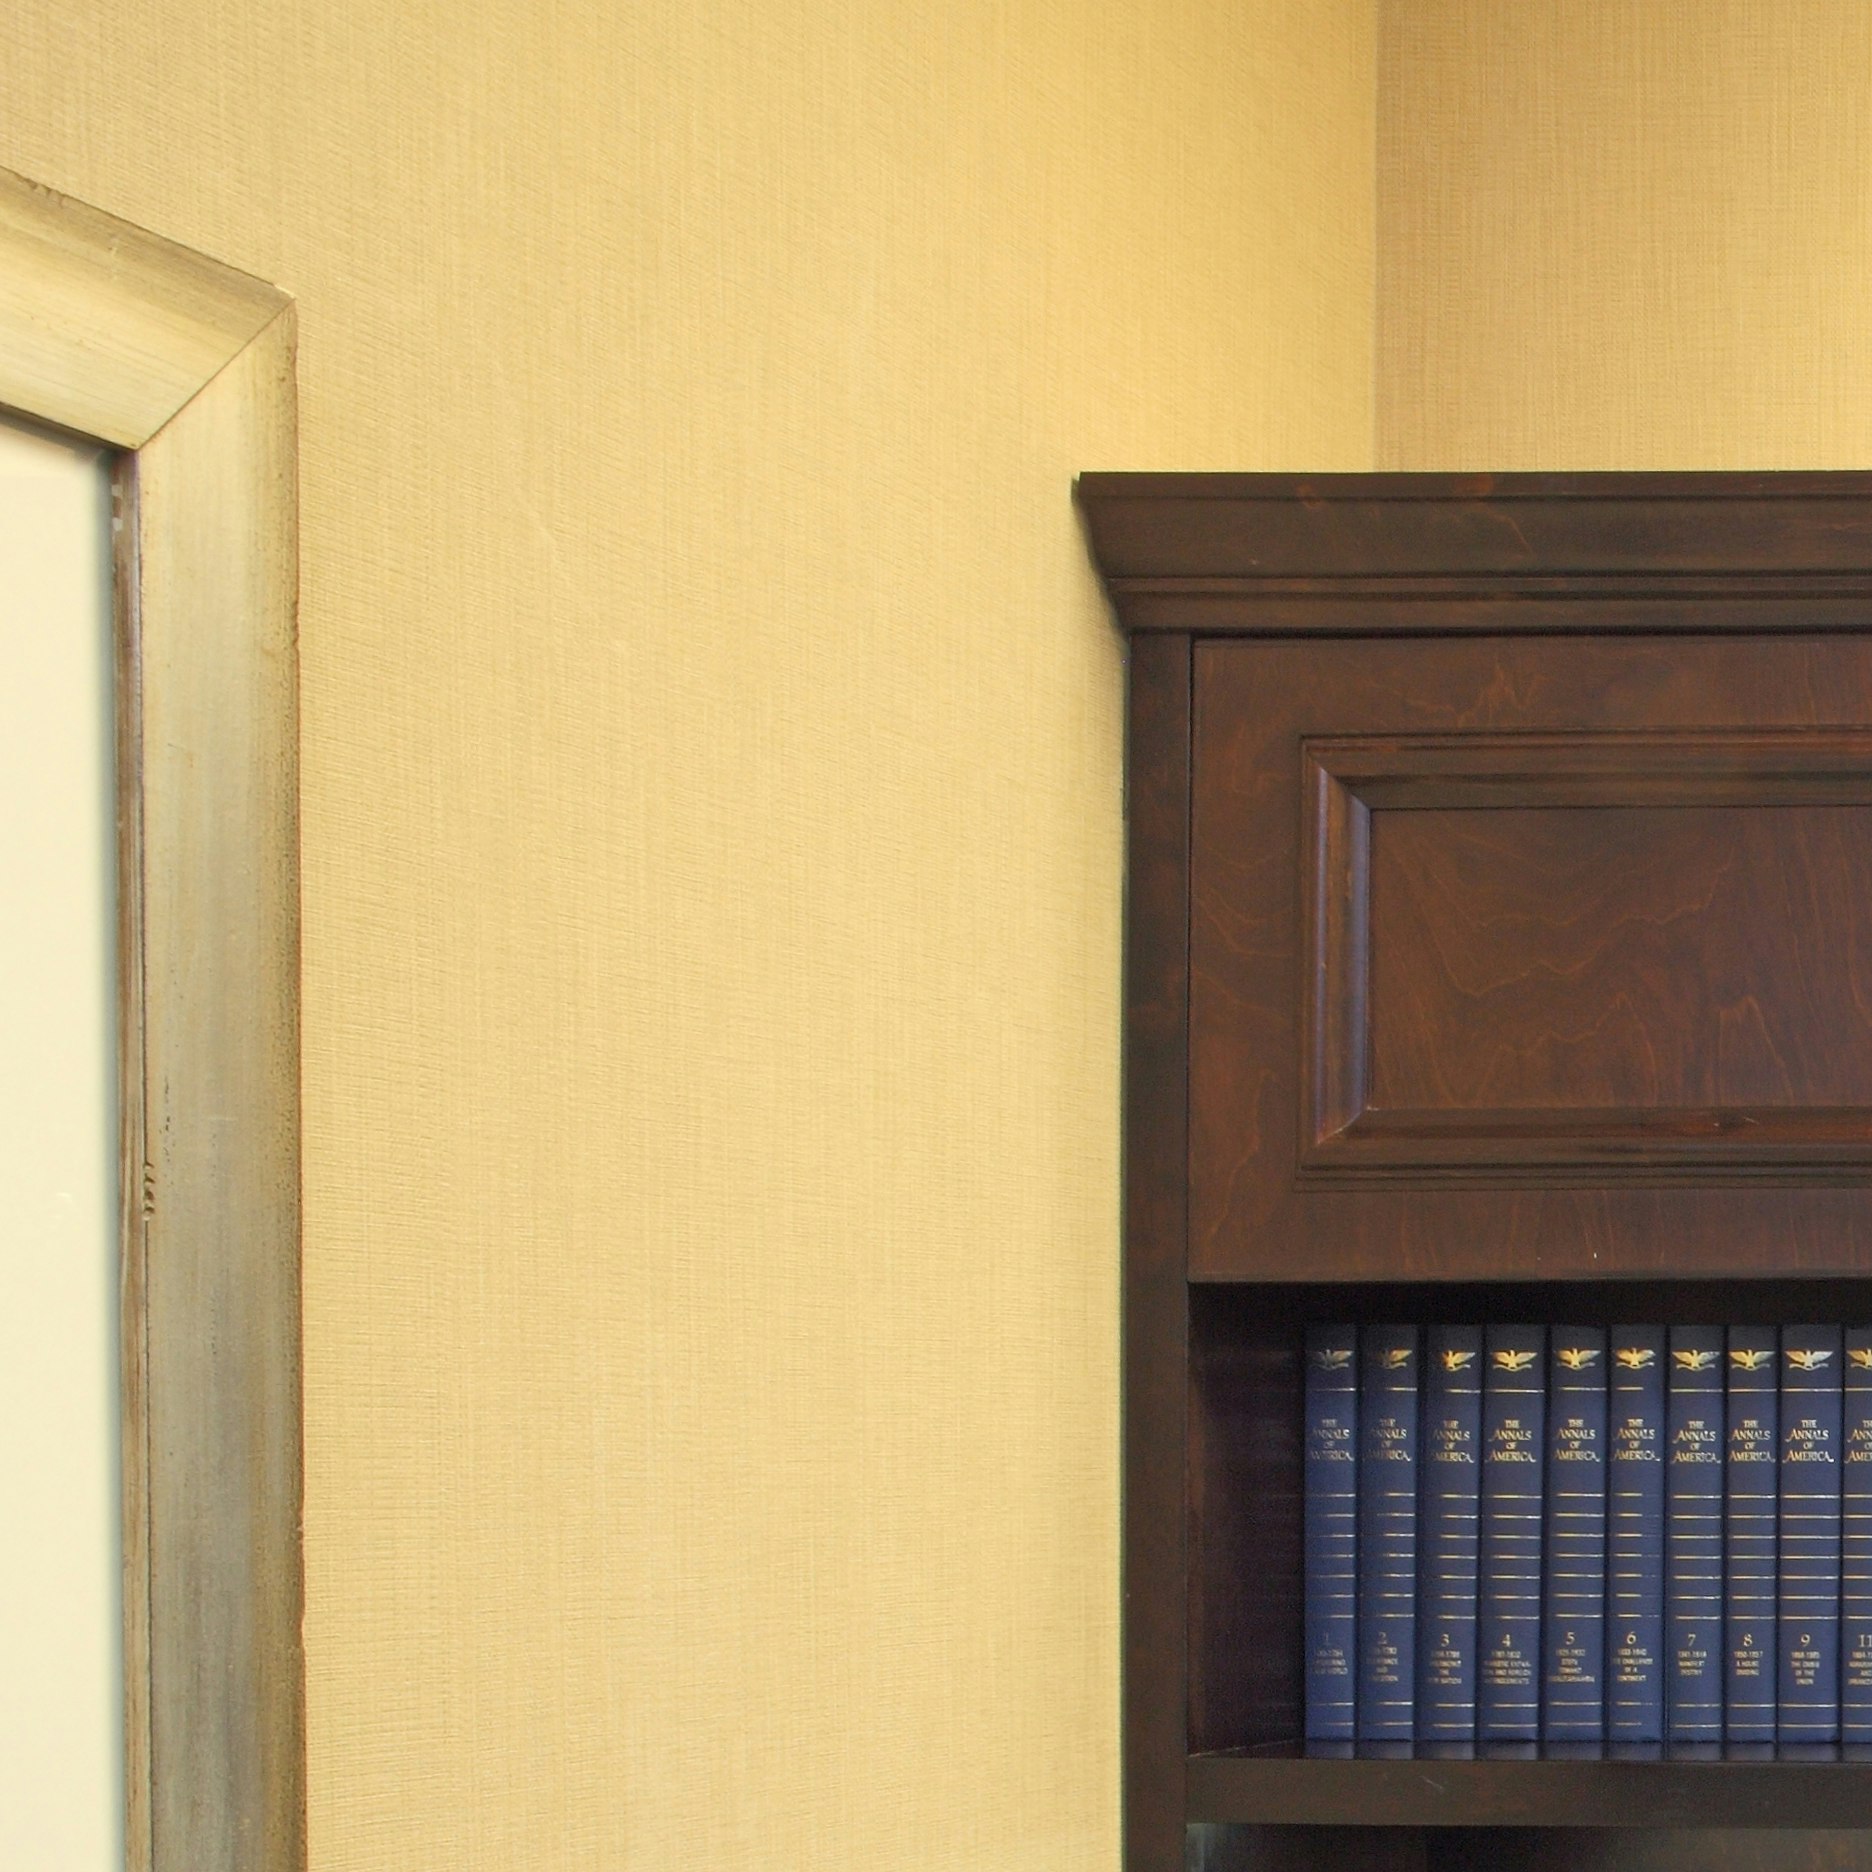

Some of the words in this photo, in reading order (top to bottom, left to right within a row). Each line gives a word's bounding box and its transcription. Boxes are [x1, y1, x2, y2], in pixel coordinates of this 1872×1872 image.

[1505, 1420, 1520, 1428] THE
[1568, 1419, 1583, 1427] THE
[1627, 1419, 1643, 1427] THE
[1688, 1421, 1704, 1429] THE
[1744, 1420, 1759, 1428] THE
[1802, 1420, 1817, 1428] THE
[1488, 1430, 1532, 1442] ANNALS
[1554, 1429, 1595, 1440] ANNALS
[1614, 1429, 1655, 1440] ANNALS
[1672, 1431, 1716, 1444] ANNALS
[1729, 1430, 1771, 1441] ANNALS
[1785, 1430, 1829, 1442] ANNALS
[1506, 1442, 1516, 1450] OF
[1690, 1443, 1700, 1451] OF
[1745, 1442, 1755, 1450] OF
[1485, 1451, 1536, 1463] AMERICA
[1555, 1451, 1600, 1462] AMERICA
[1612, 1451, 1661, 1462] AMERICA
[1672, 1452, 1720, 1464] AMERICA
[1728, 1451, 1776, 1463] AMERICA
[1782, 1451, 1834, 1463] AMERICA
[1379, 1632, 1388, 1645] 2
[1441, 1634, 1449, 1647] 3
[1502, 1634, 1511, 1647] 4
[1566, 1632, 1575, 1645] 5
[1627, 1631, 1636, 1644] 6
[1688, 1634, 1696, 1646] 7
[1744, 1633, 1753, 1646] 8
[1801, 1635, 1810, 1647] 9
